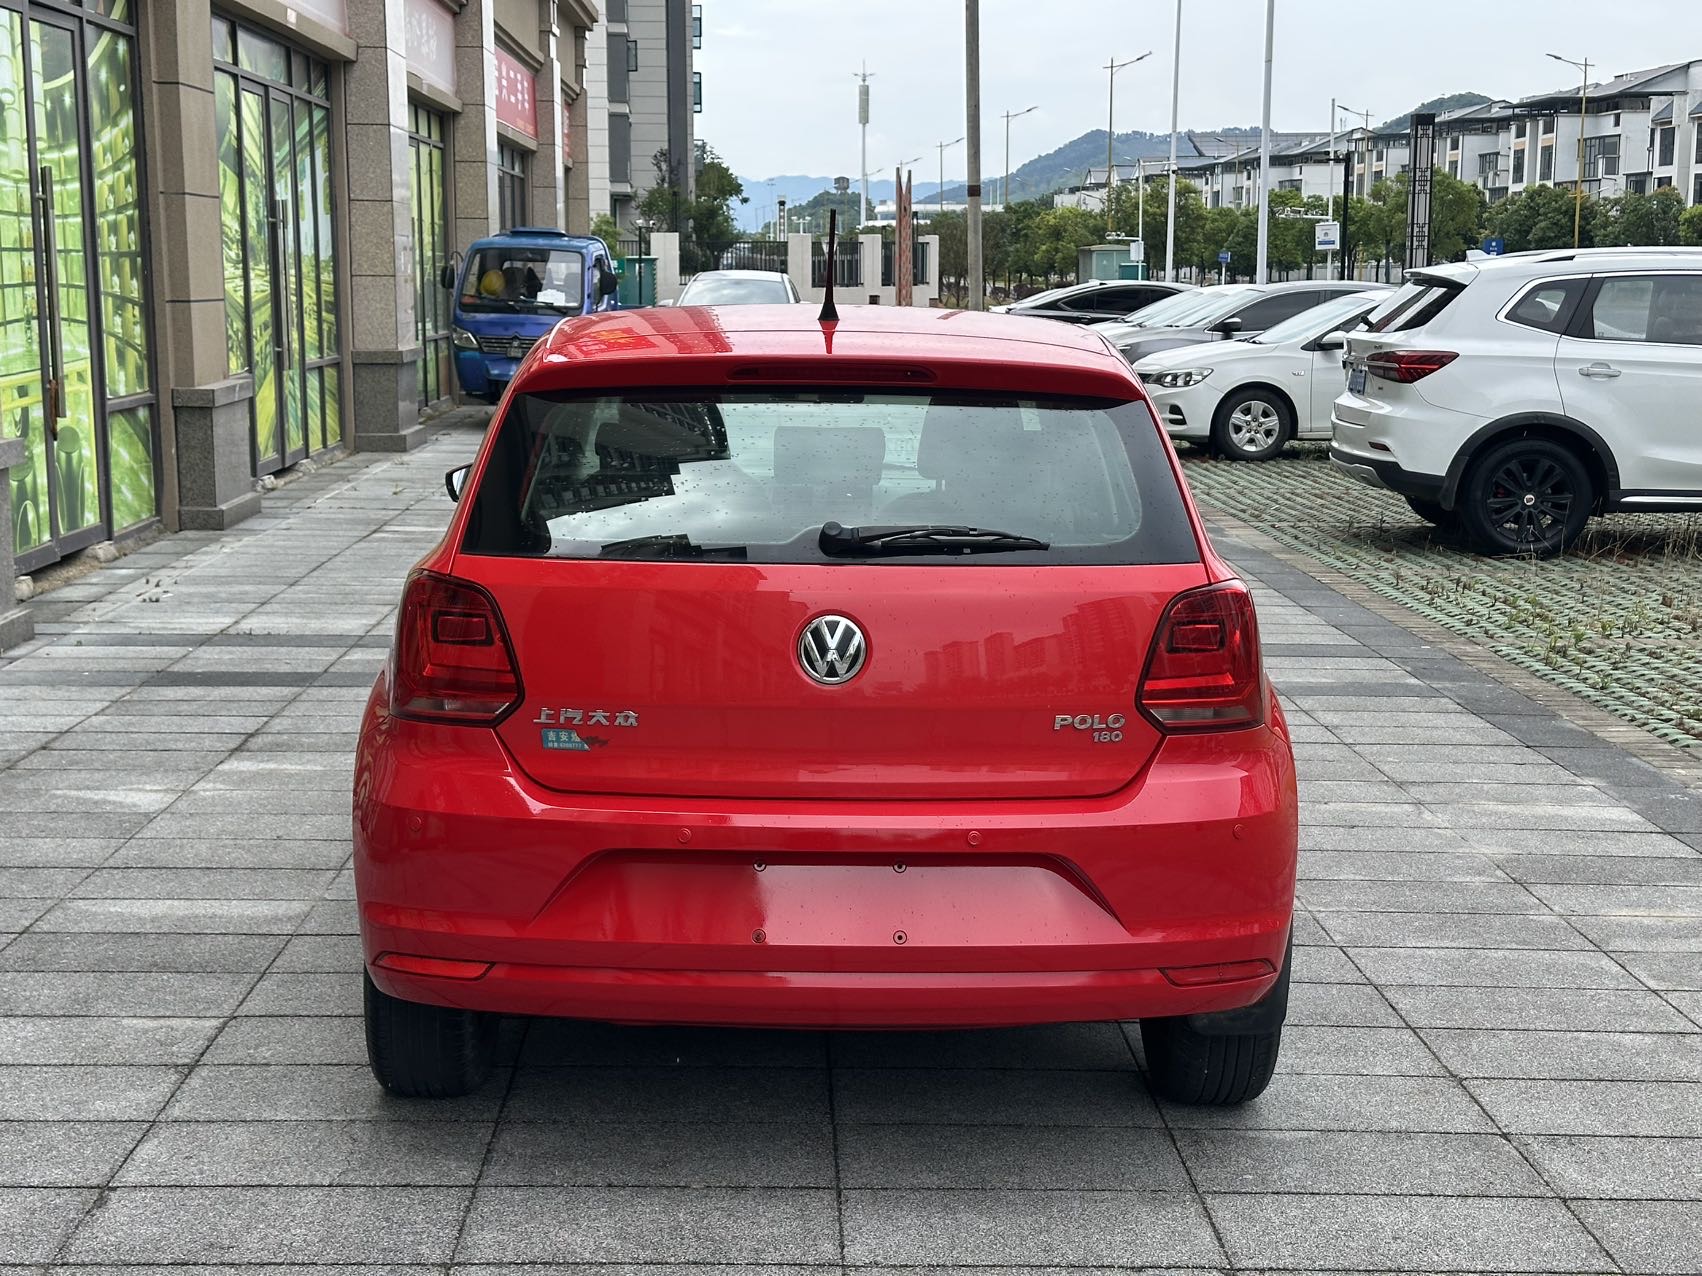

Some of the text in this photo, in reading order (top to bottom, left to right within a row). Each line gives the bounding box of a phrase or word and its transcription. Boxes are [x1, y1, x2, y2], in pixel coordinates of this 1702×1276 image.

[533, 707, 639, 726] 上汽大众
[1054, 713, 1125, 730] POLO
[1093, 731, 1122, 742] 180
